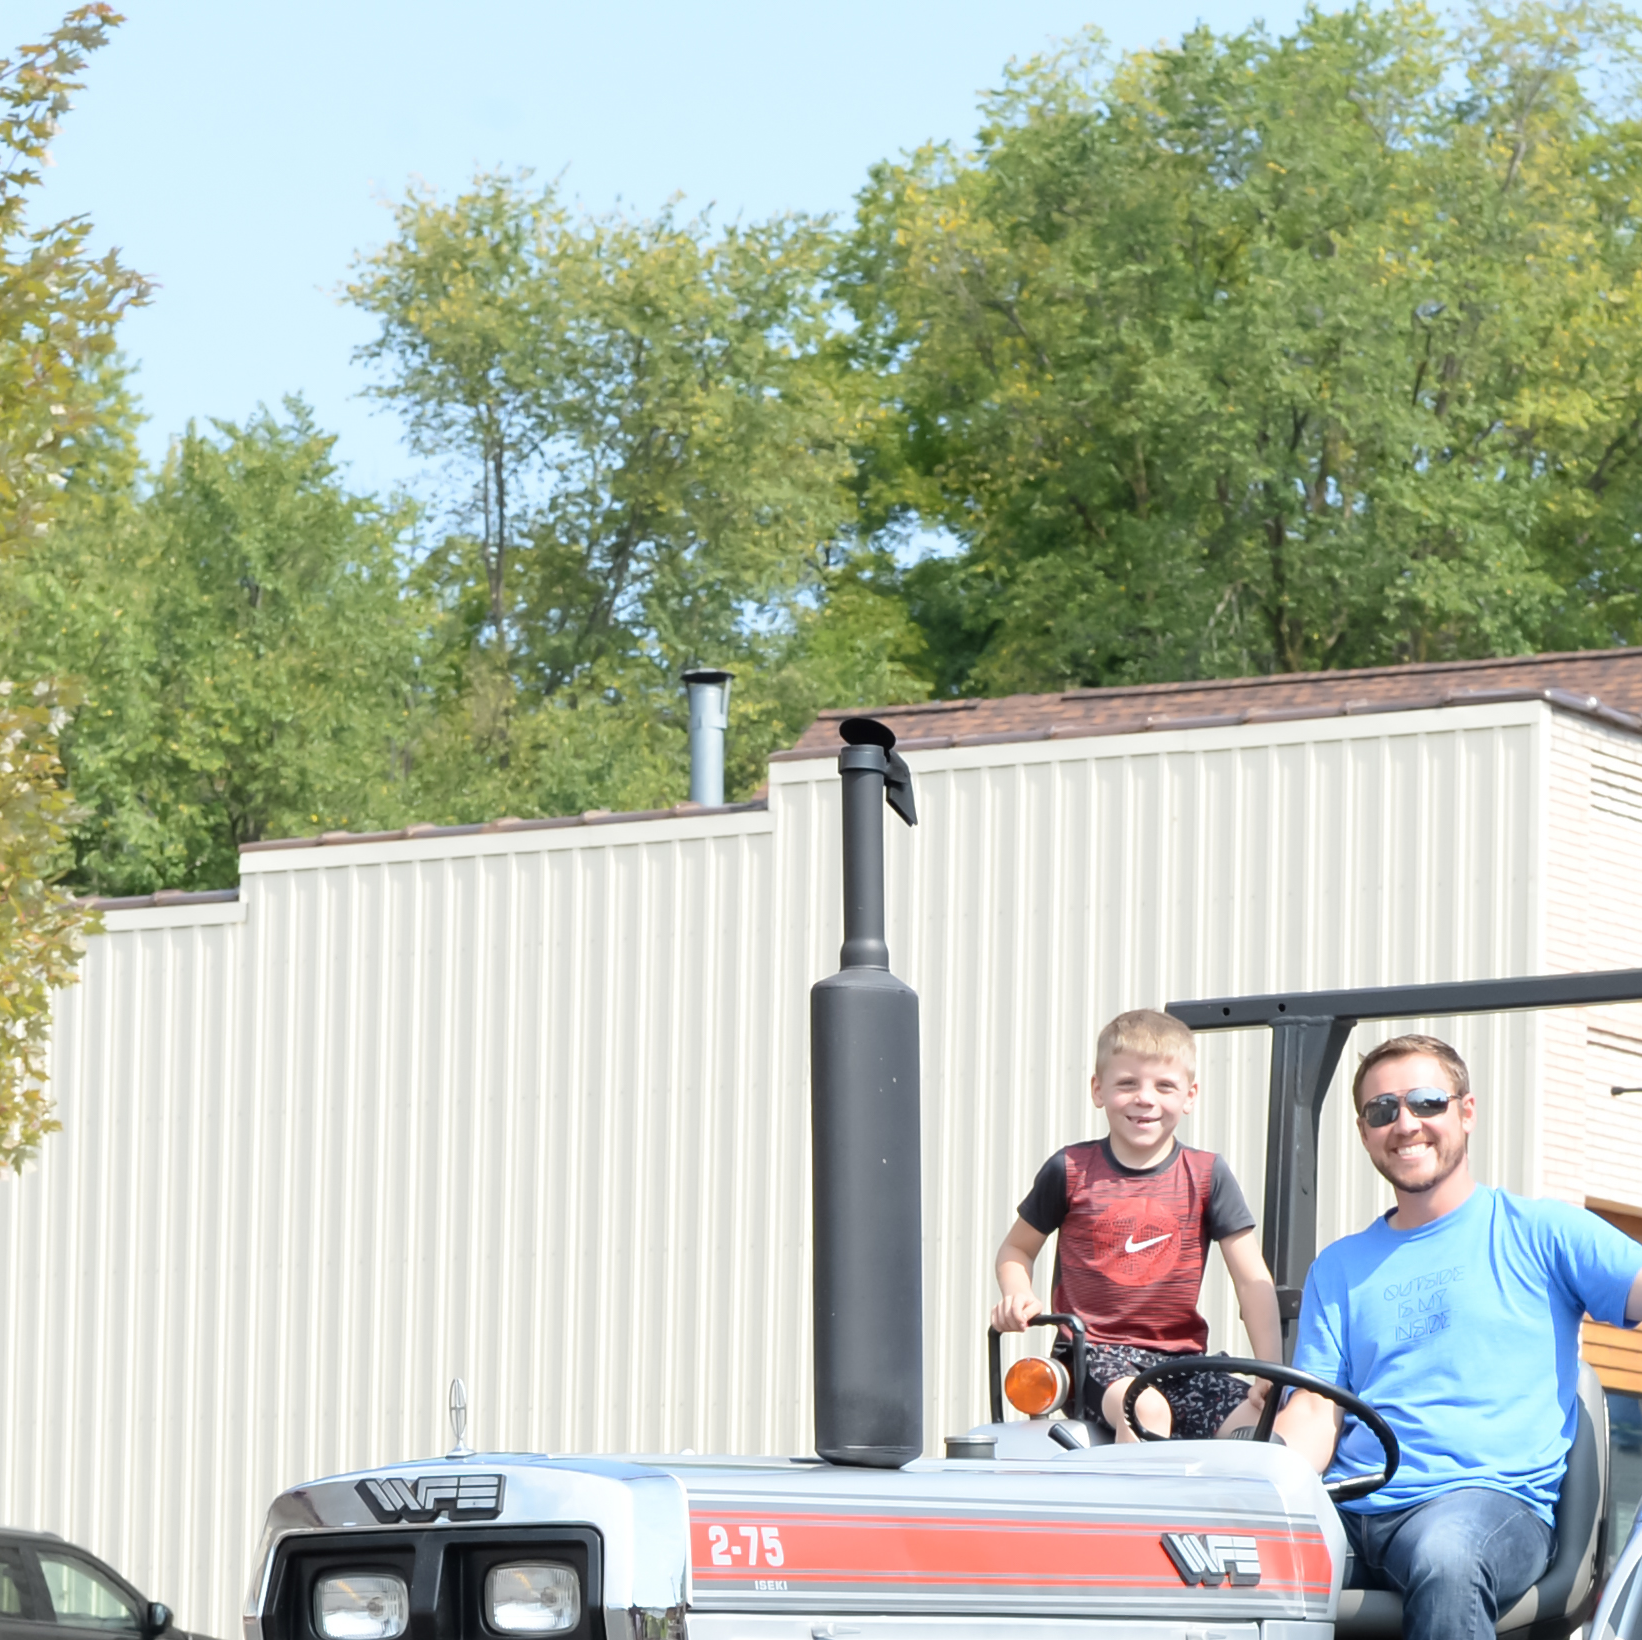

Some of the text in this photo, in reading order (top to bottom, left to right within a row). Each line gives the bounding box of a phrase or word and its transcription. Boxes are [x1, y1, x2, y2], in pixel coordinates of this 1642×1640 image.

[1383, 1265, 1466, 1301] OUTSIDE
[1397, 1287, 1448, 1319] IS MY
[1395, 1308, 1451, 1342] INSIDE
[708, 1525, 785, 1567] 2-75
[754, 1580, 788, 1591] ISEKI
